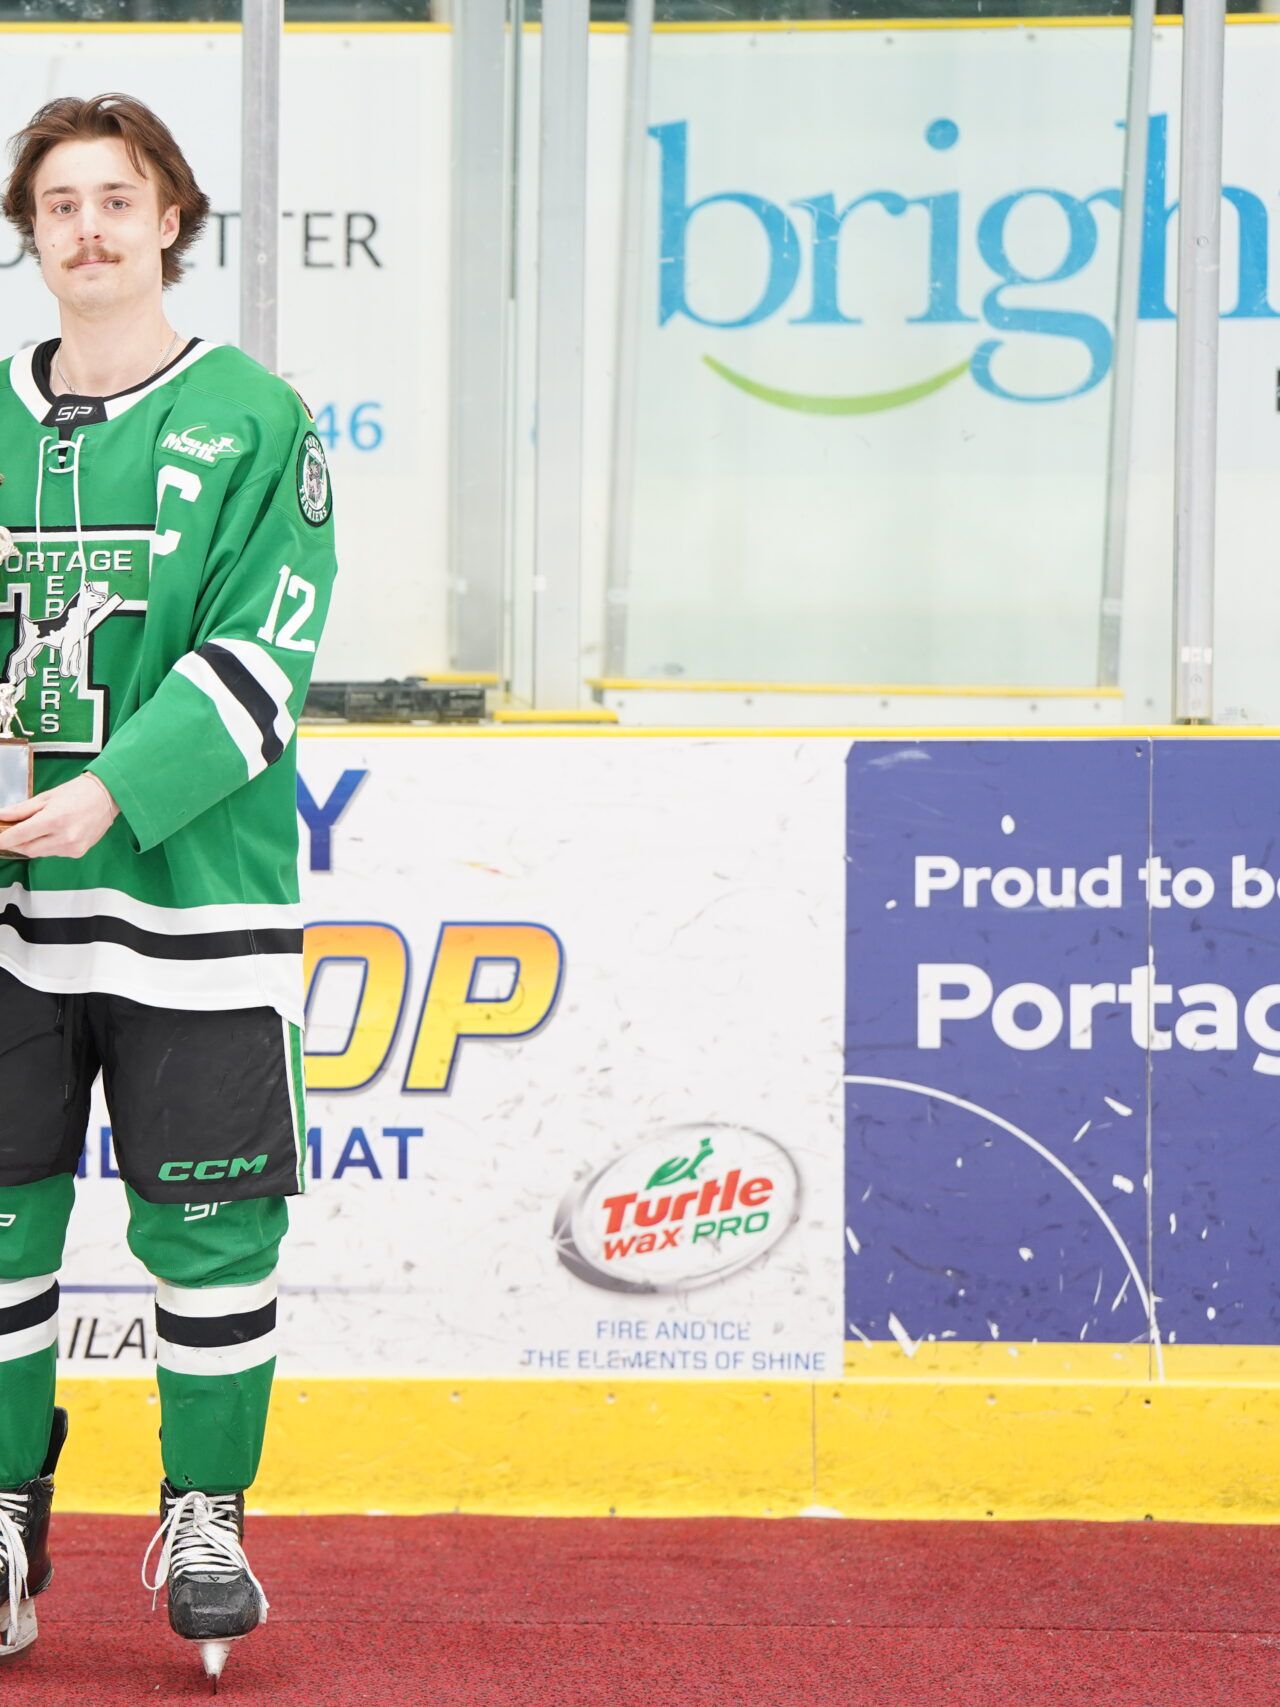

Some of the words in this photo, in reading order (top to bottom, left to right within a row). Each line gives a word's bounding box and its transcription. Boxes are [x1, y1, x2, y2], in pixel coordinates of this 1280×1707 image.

[647, 113, 1280, 405] brigh
[153, 465, 202, 556] C
[258, 565, 317, 653] 12
[915, 854, 1122, 908] Proud
[1138, 855, 1215, 908] to
[1232, 854, 1280, 908] b
[158, 1154, 268, 1182] CCM
[602, 1169, 774, 1235] Turtle
[603, 1227, 682, 1261] wax
[692, 1211, 769, 1244] PRO
[597, 1321, 648, 1340] FIRE
[656, 1321, 706, 1340] AND
[715, 1351, 745, 1370] OF
[752, 1351, 825, 1371] SHINE
